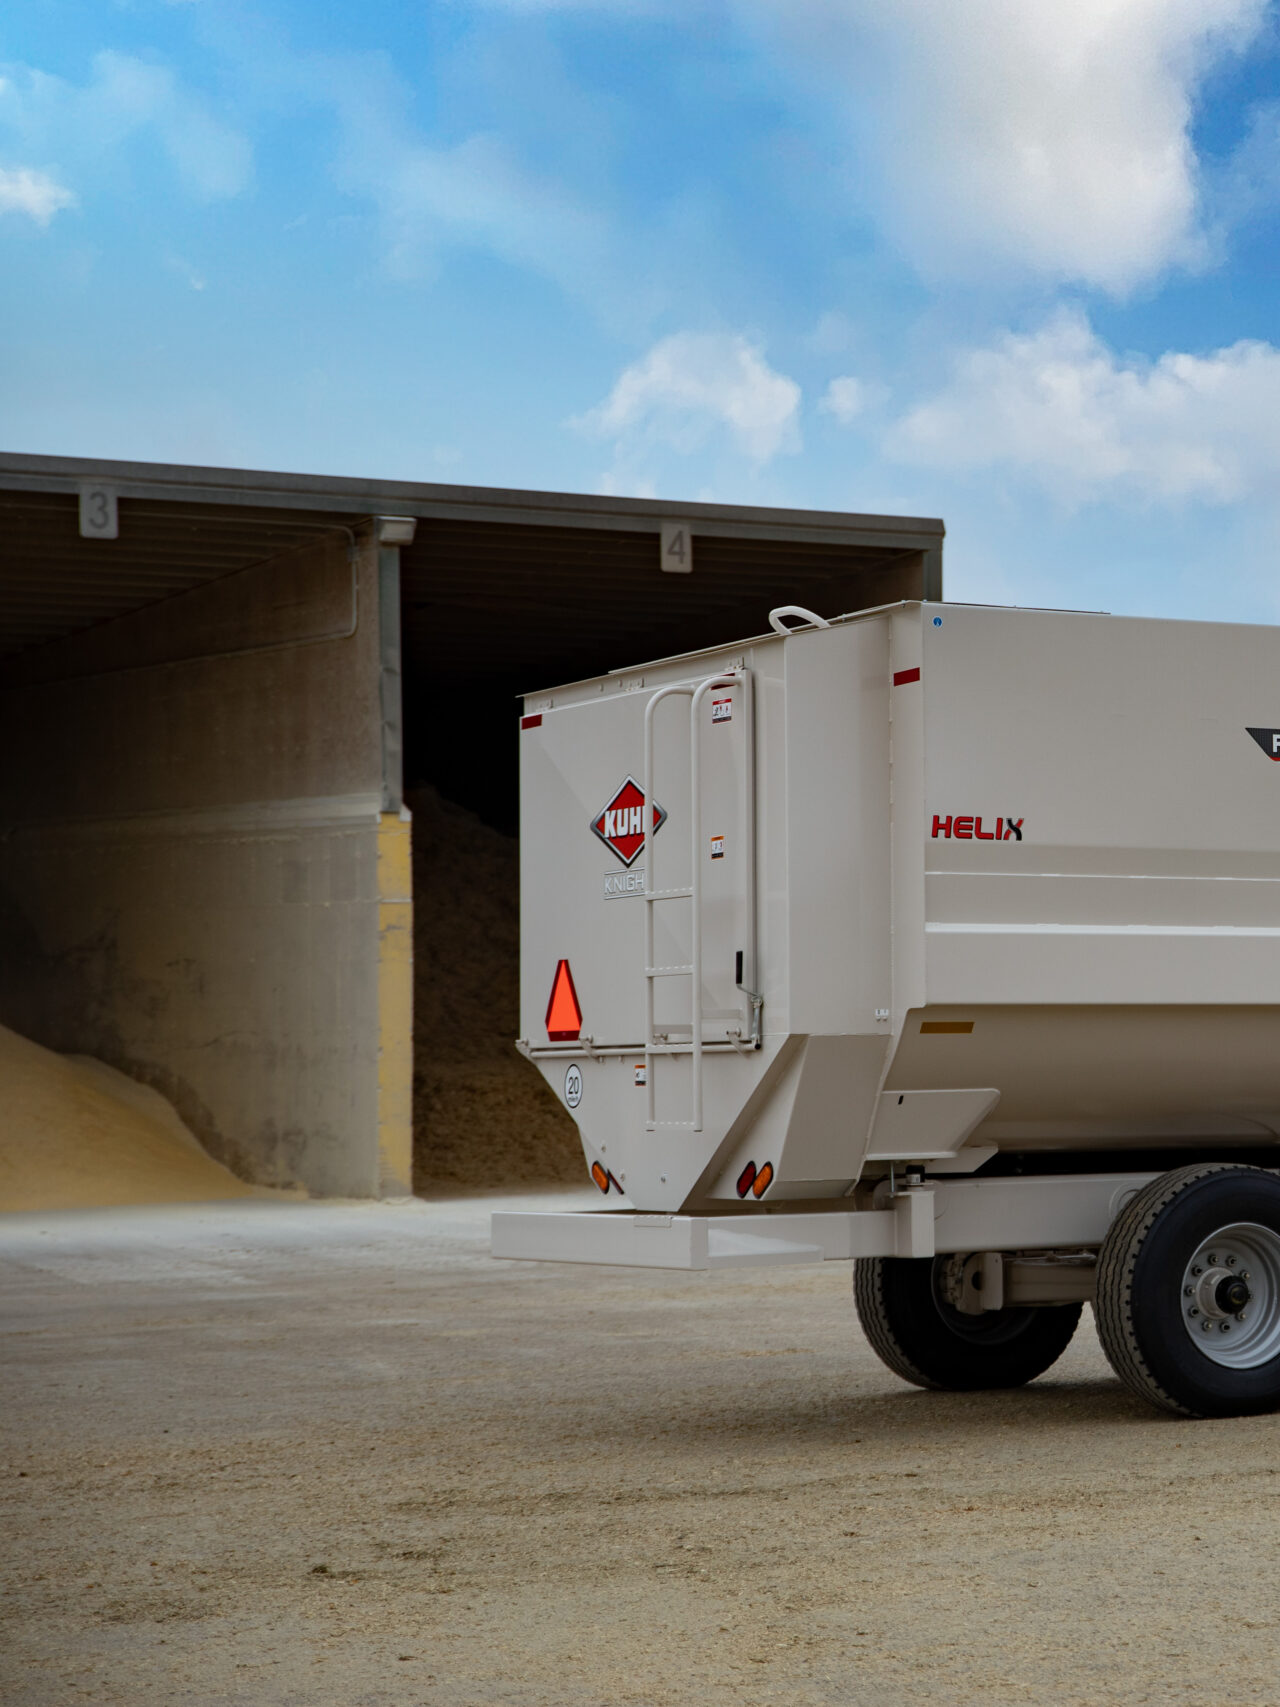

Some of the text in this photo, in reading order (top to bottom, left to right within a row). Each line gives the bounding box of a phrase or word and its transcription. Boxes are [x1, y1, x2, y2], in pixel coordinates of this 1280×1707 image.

[89, 491, 110, 530] 3
[667, 530, 686, 565] 4
[931, 815, 1024, 841] HELIX
[568, 1076, 580, 1095] 20
